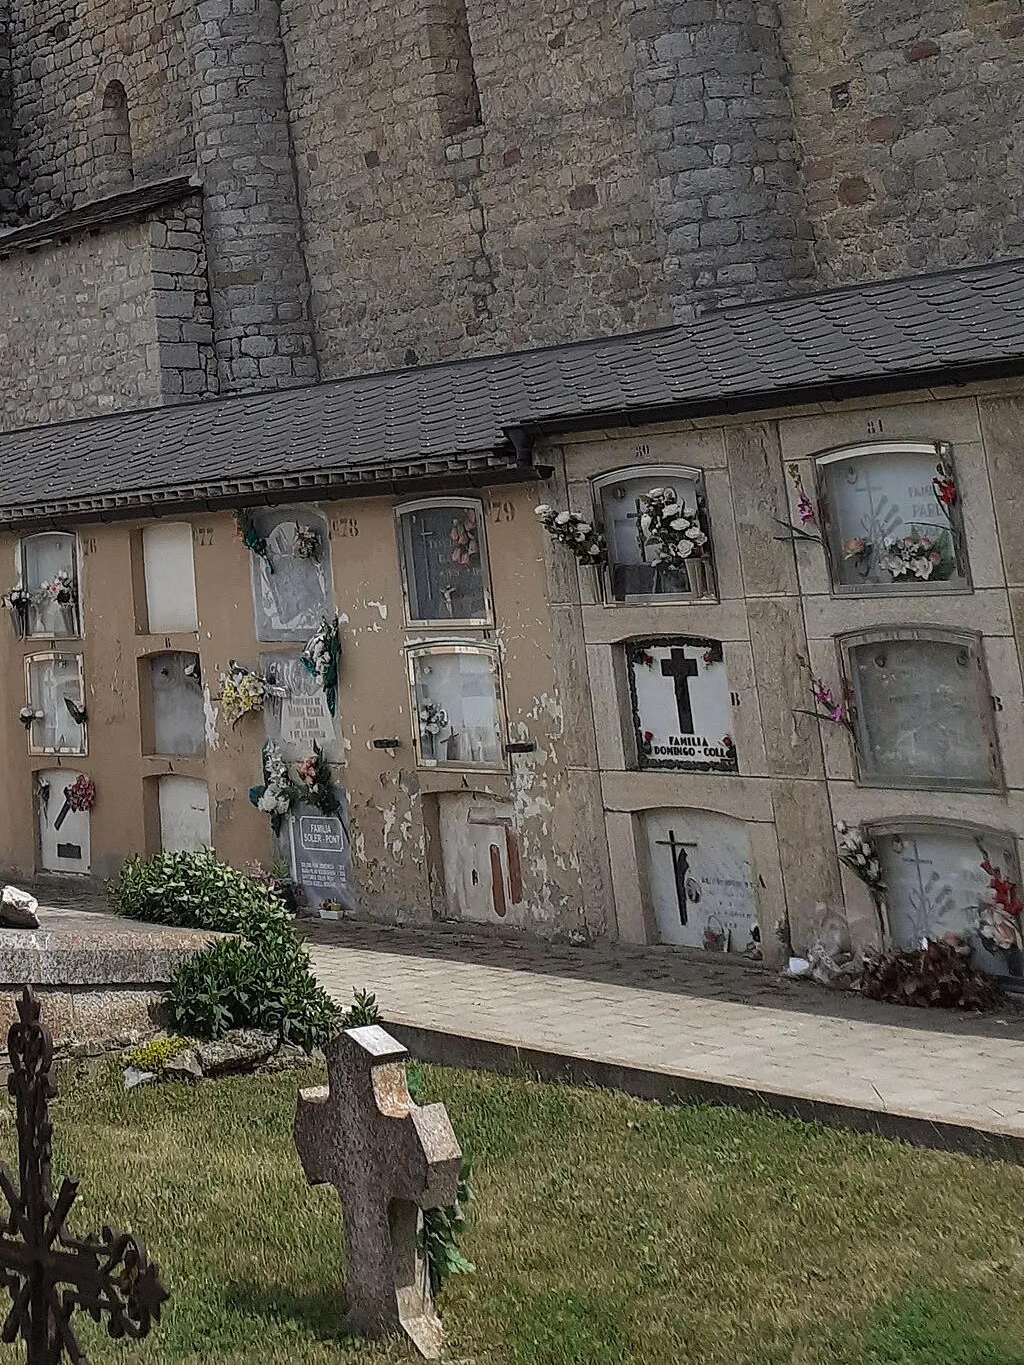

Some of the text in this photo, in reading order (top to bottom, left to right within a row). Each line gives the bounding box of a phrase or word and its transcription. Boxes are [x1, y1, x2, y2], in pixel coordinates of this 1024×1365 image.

[730, 692, 740, 706] B
[668, 736, 709, 747] FAMILIA
[654, 746, 696, 756] DOMINGO
[703, 747, 726, 758] COLL
[310, 823, 332, 834] FAMILIA
[303, 833, 322, 843] SOLER
[325, 834, 340, 844] PONT
